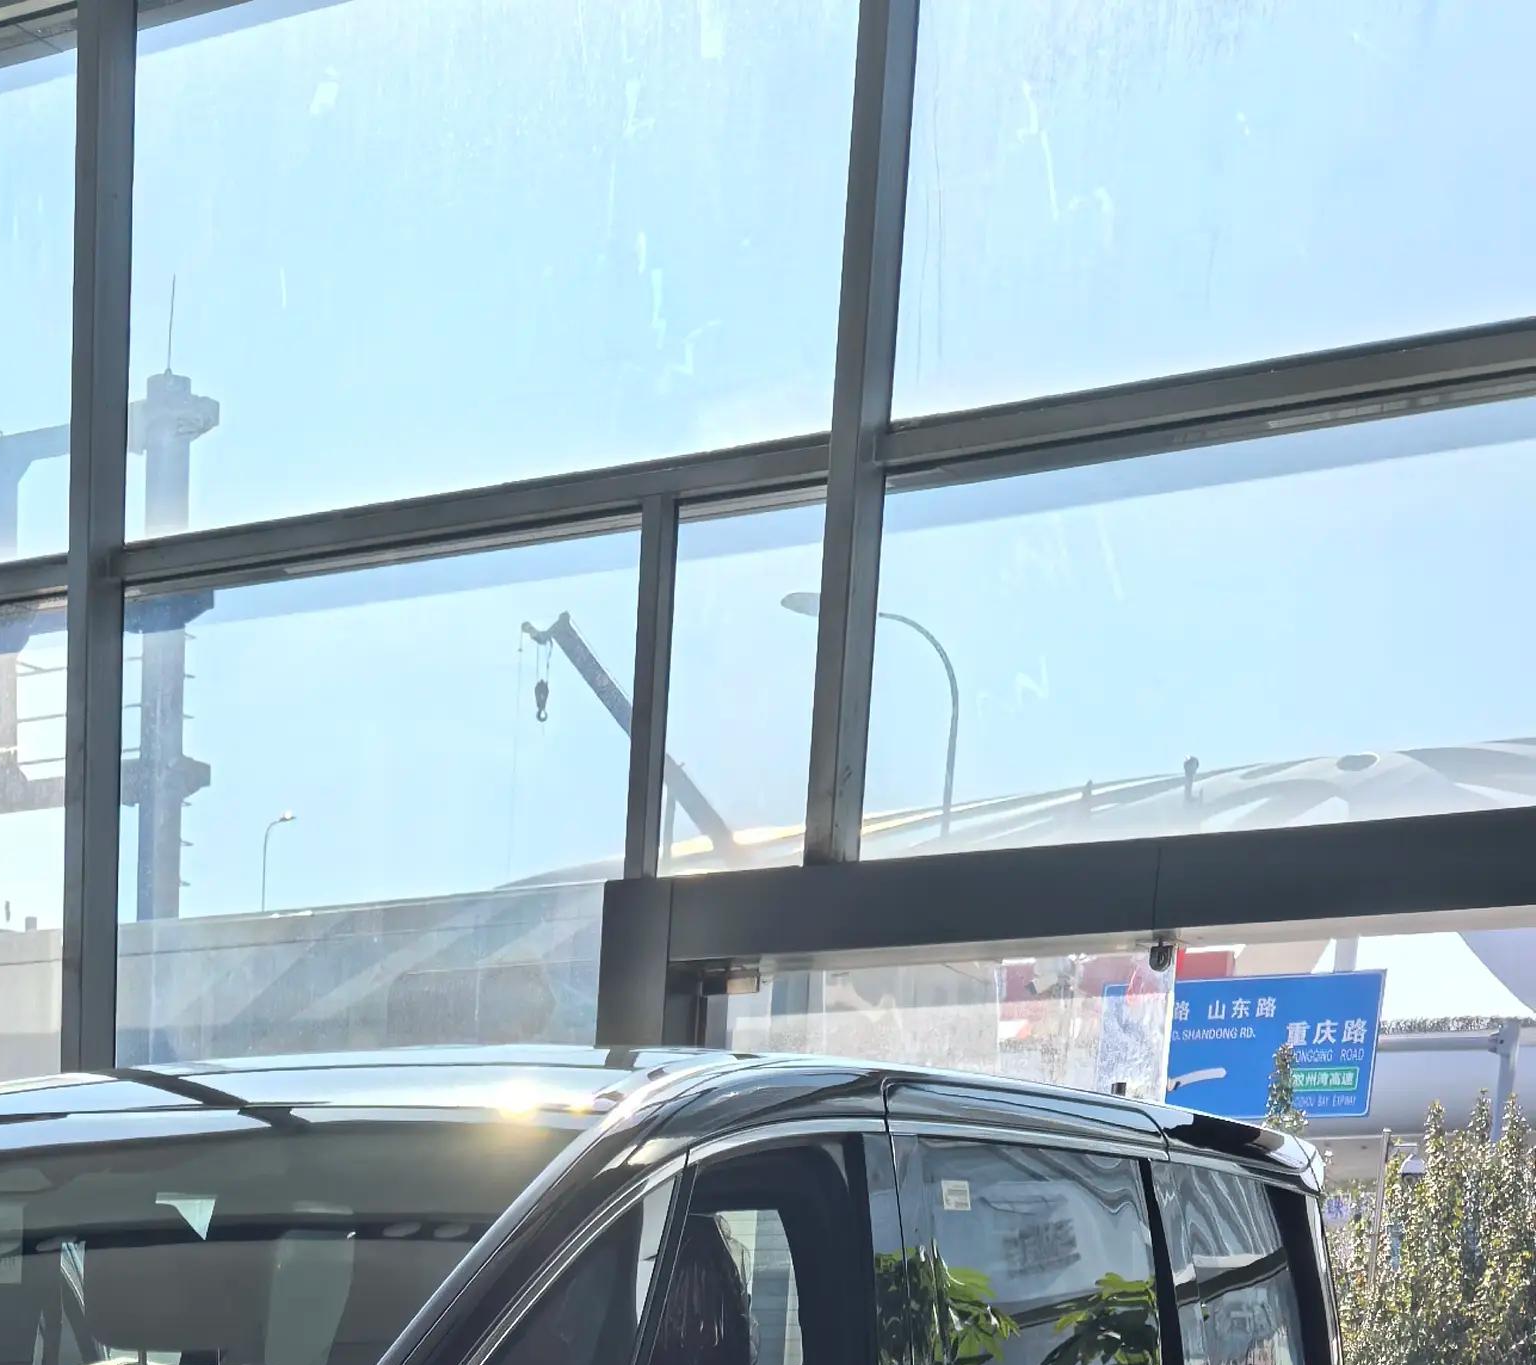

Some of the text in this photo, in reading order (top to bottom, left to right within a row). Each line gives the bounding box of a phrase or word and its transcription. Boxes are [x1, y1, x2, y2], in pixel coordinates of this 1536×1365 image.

[1207, 997, 1277, 1020] 山东路
[1182, 1027, 1238, 1041] SHANDONG
[1286, 1018, 1368, 1046] 重庆路
[1340, 1047, 1365, 1062] ROAD
